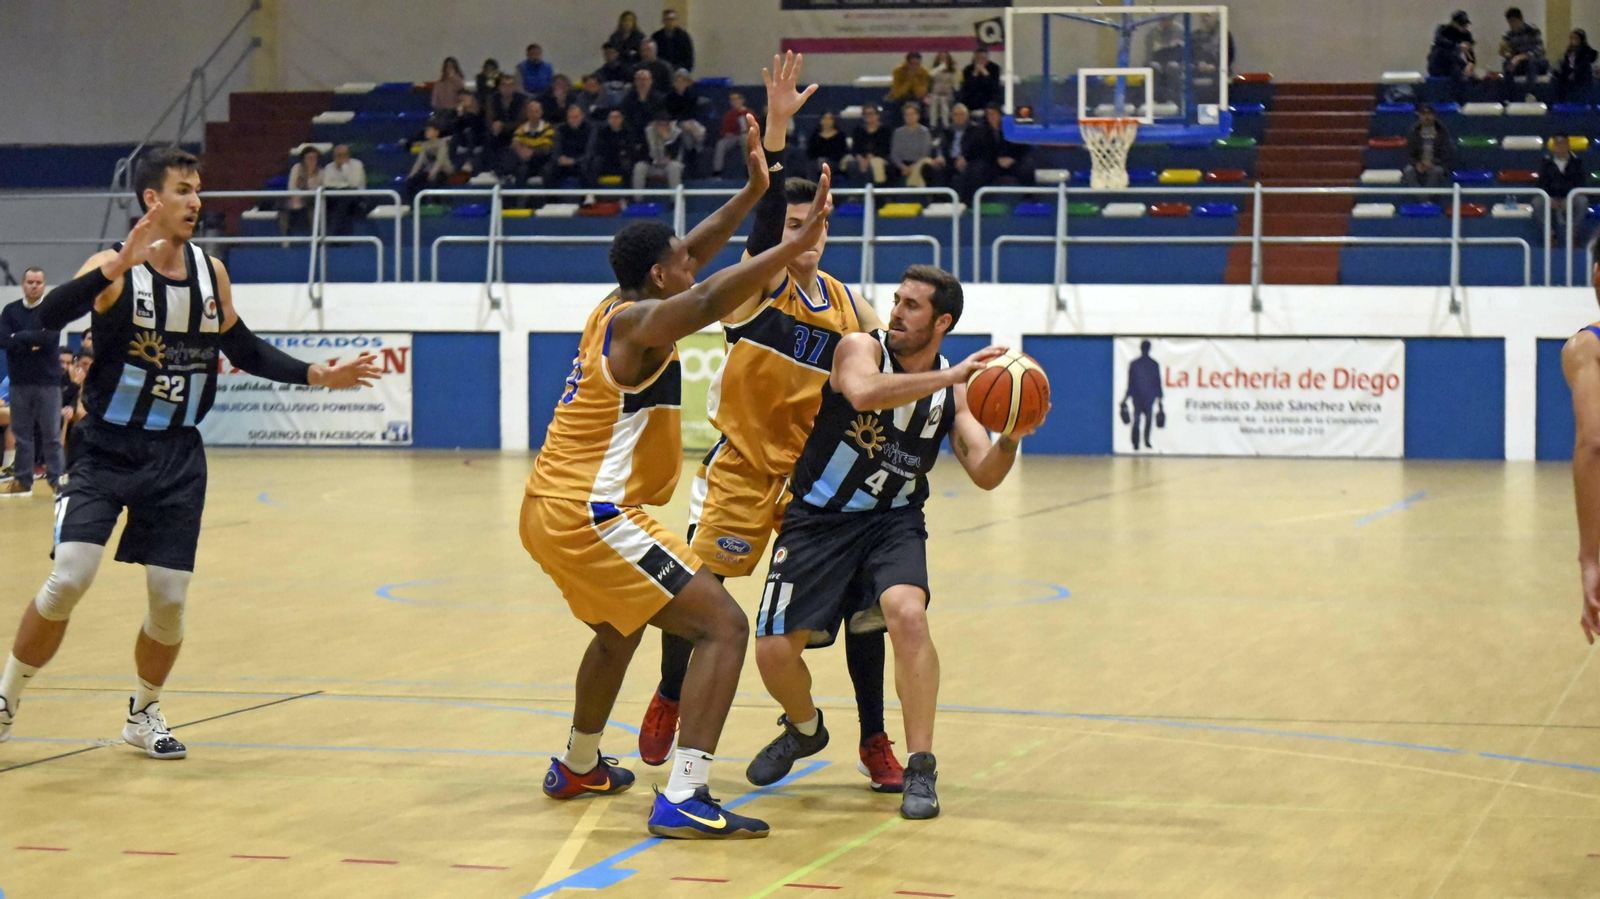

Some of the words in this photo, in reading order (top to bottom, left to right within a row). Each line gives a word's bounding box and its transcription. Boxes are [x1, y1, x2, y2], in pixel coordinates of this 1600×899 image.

[793, 324, 830, 364] 37
[151, 375, 186, 402] 22
[1165, 366, 1190, 388] La
[1298, 368, 1327, 390] de
[1333, 367, 1400, 397] Diego
[263, 402, 319, 412] EXCLUSIVO
[322, 402, 386, 412] POWERKING
[1185, 397, 1250, 410] Francisco
[1254, 398, 1284, 411] José
[1348, 400, 1381, 412] Vera
[303, 431, 317, 440] EN
[319, 431, 376, 441] FACEBOOK
[864, 468, 890, 496] 4
[722, 538, 746, 553] Ford
[657, 560, 676, 581] vive
